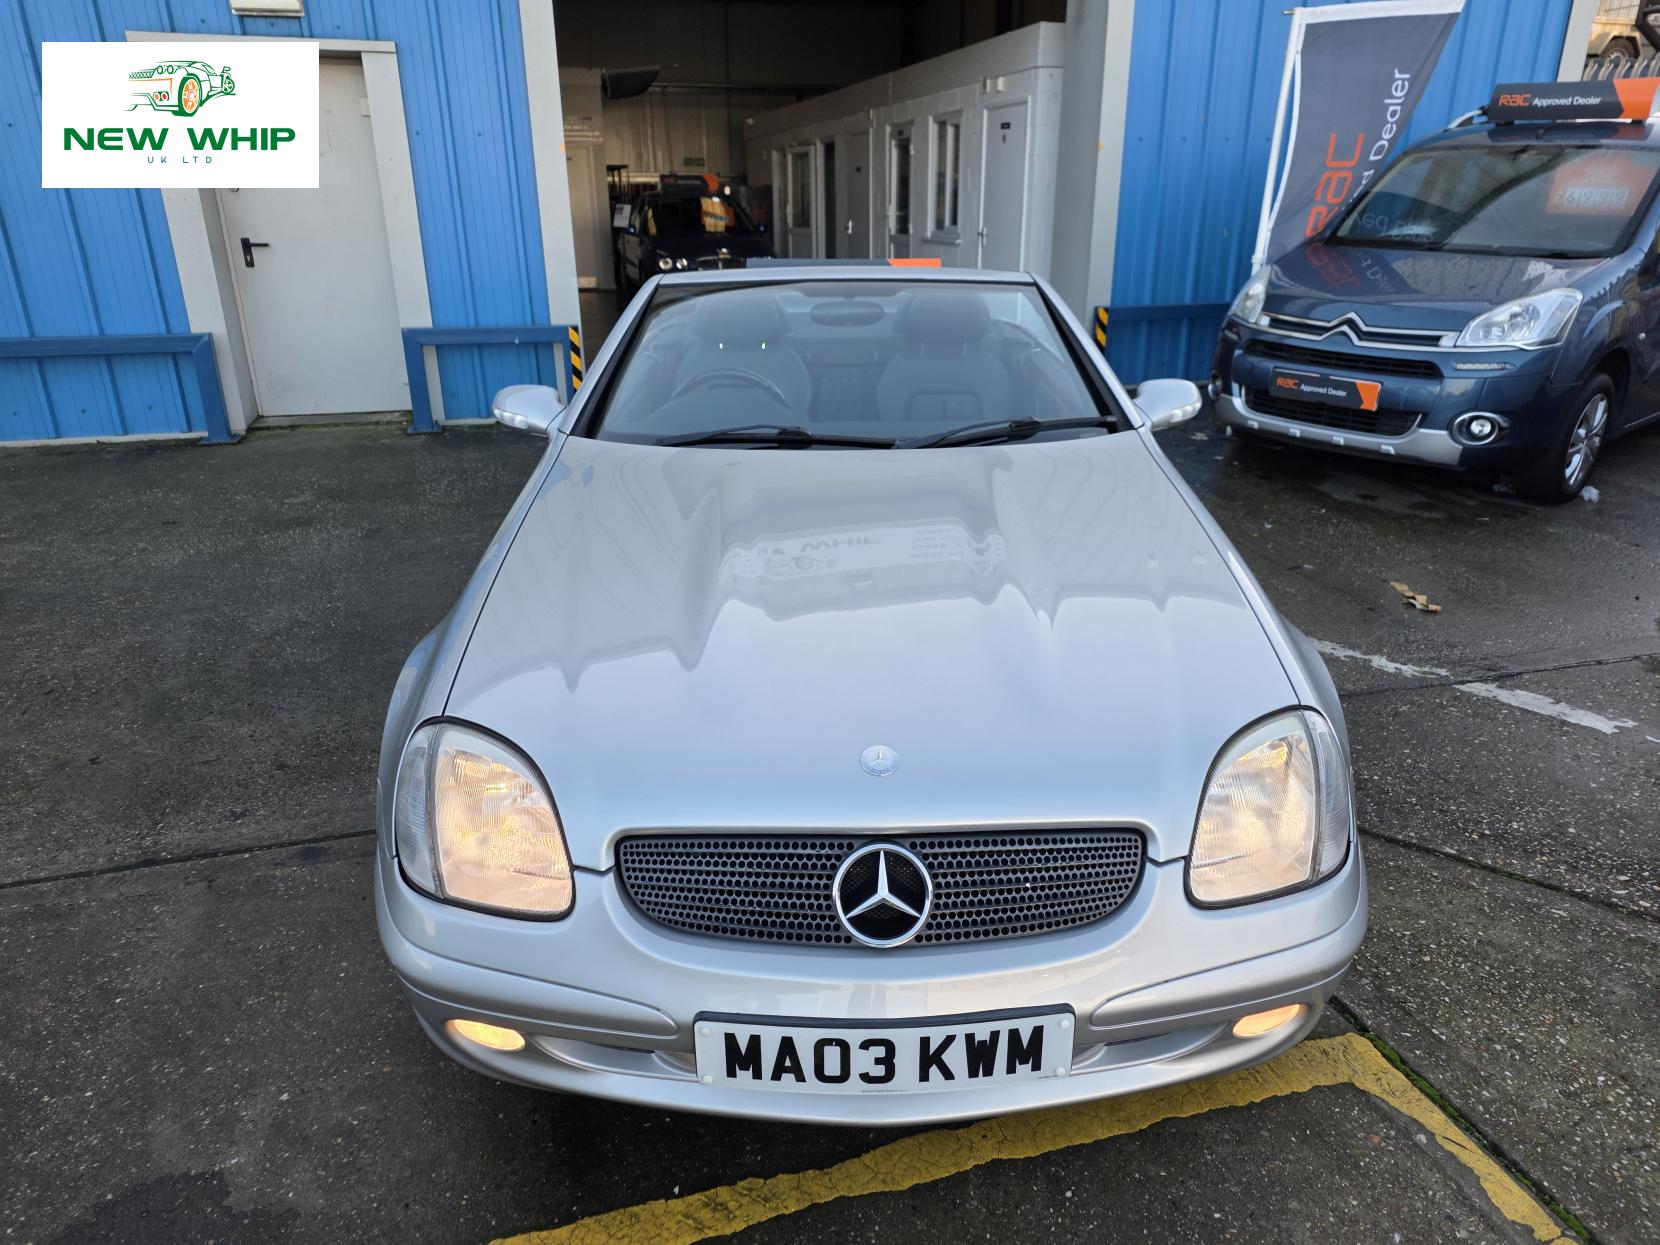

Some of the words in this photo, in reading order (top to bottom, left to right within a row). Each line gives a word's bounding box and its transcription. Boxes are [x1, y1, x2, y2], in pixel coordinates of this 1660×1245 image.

[1369, 68, 1410, 161] Dealer
[1532, 96, 1572, 108] Approved
[1573, 96, 1602, 106] Dealer
[1300, 383, 1327, 395] Approved
[1328, 386, 1347, 397] Dealer
[723, 1032, 896, 1085] MA03
[918, 1025, 1044, 1083] KWM
